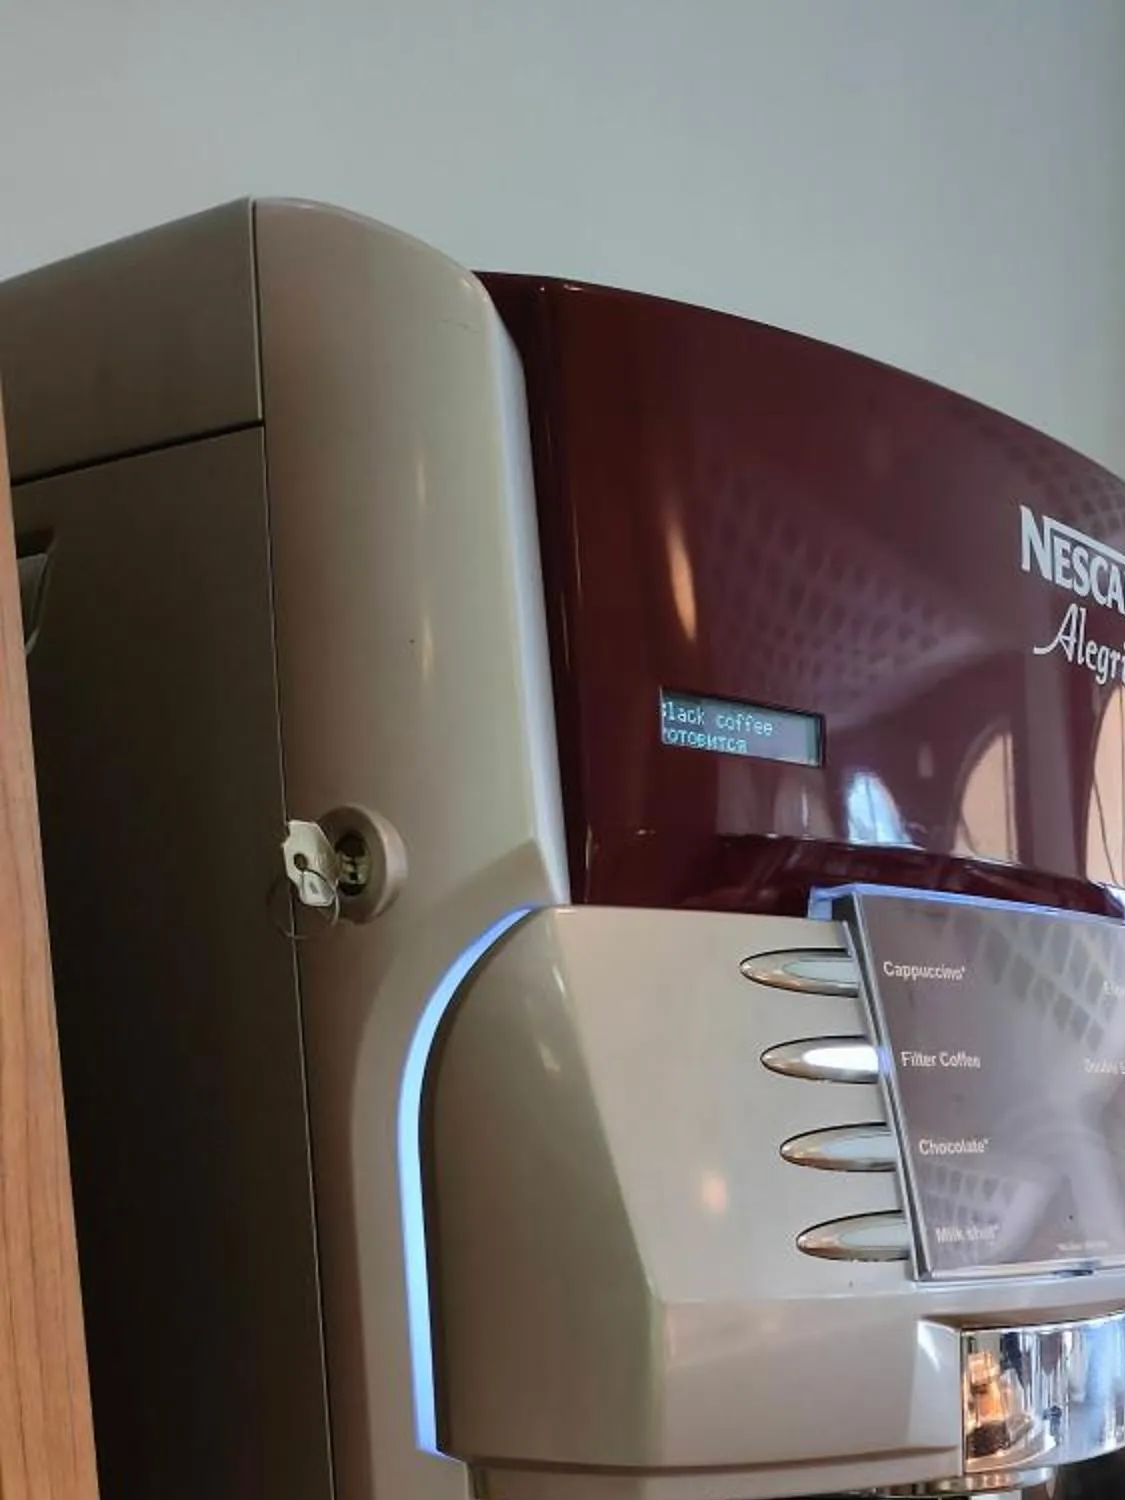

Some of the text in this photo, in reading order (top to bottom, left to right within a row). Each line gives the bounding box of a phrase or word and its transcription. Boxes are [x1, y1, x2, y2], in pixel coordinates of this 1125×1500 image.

[716, 714, 773, 736] coffee
[901, 1051, 981, 1069] Filter Coffee
